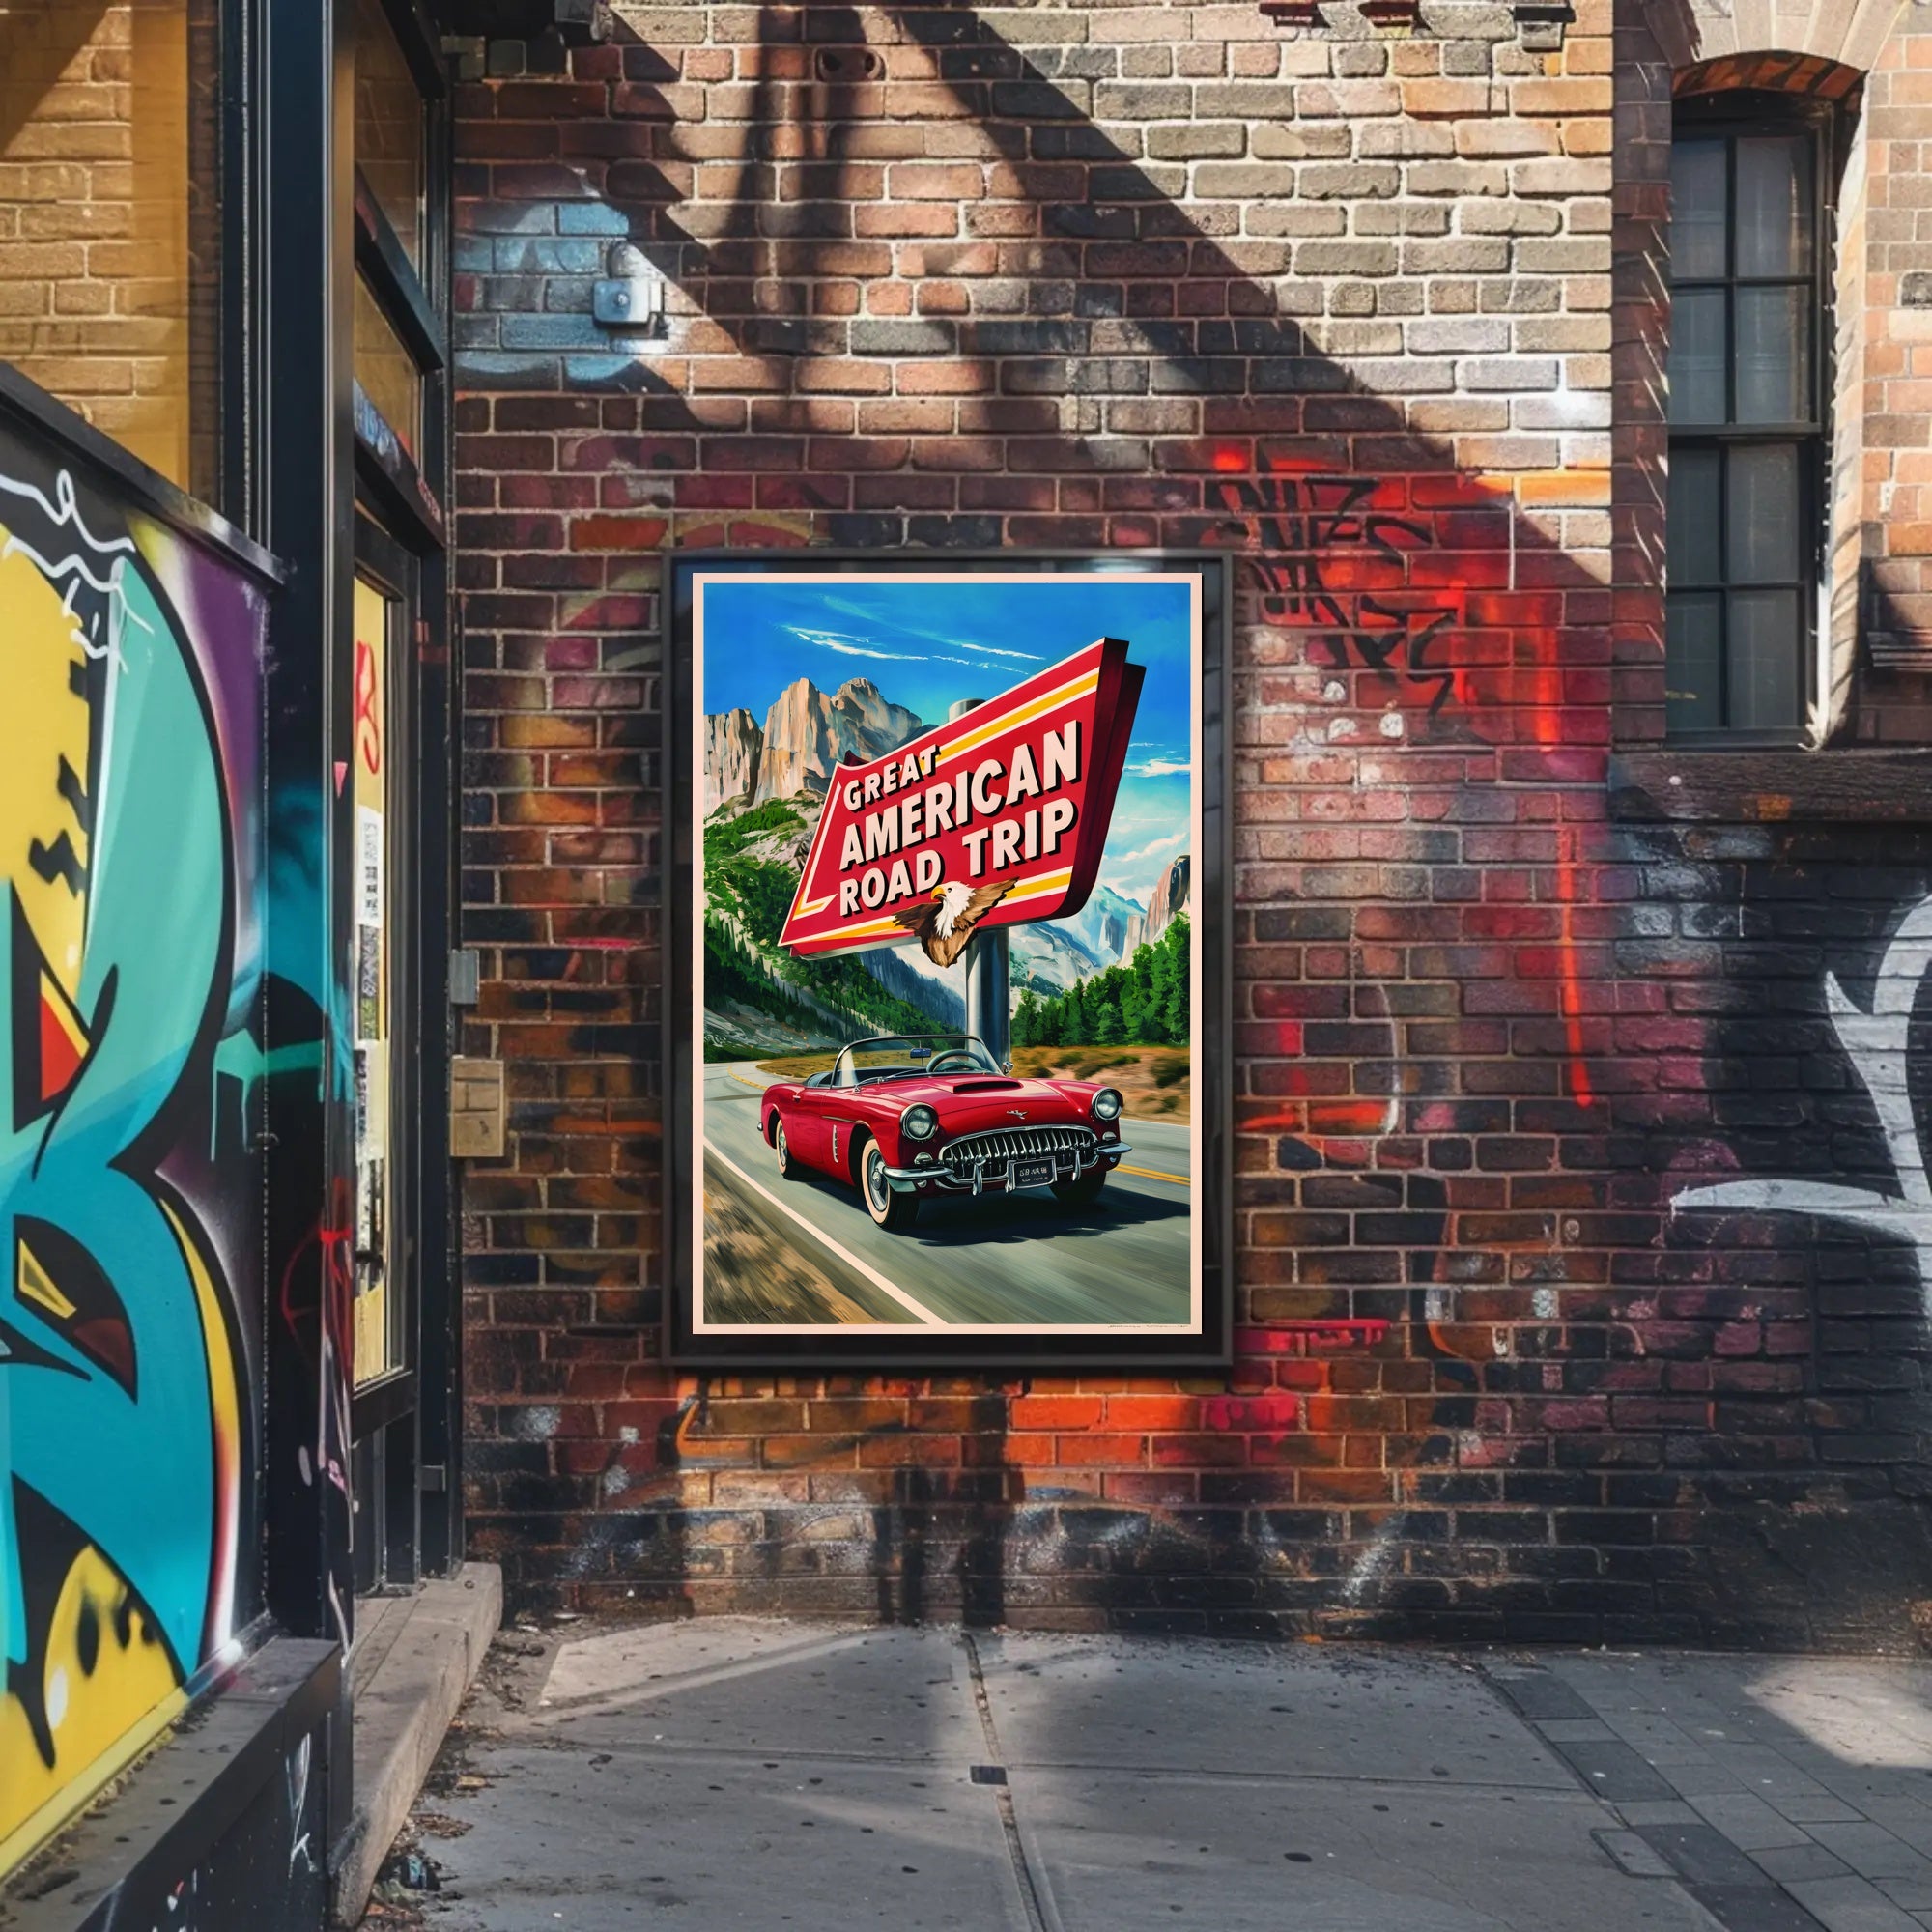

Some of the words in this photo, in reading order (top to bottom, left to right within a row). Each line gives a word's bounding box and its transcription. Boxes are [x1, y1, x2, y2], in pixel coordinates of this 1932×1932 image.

[841, 720, 1081, 870] AMERICAN
[843, 745, 941, 810] GREAT
[839, 849, 944, 917] ROAD
[962, 798, 1077, 877] TRIP
